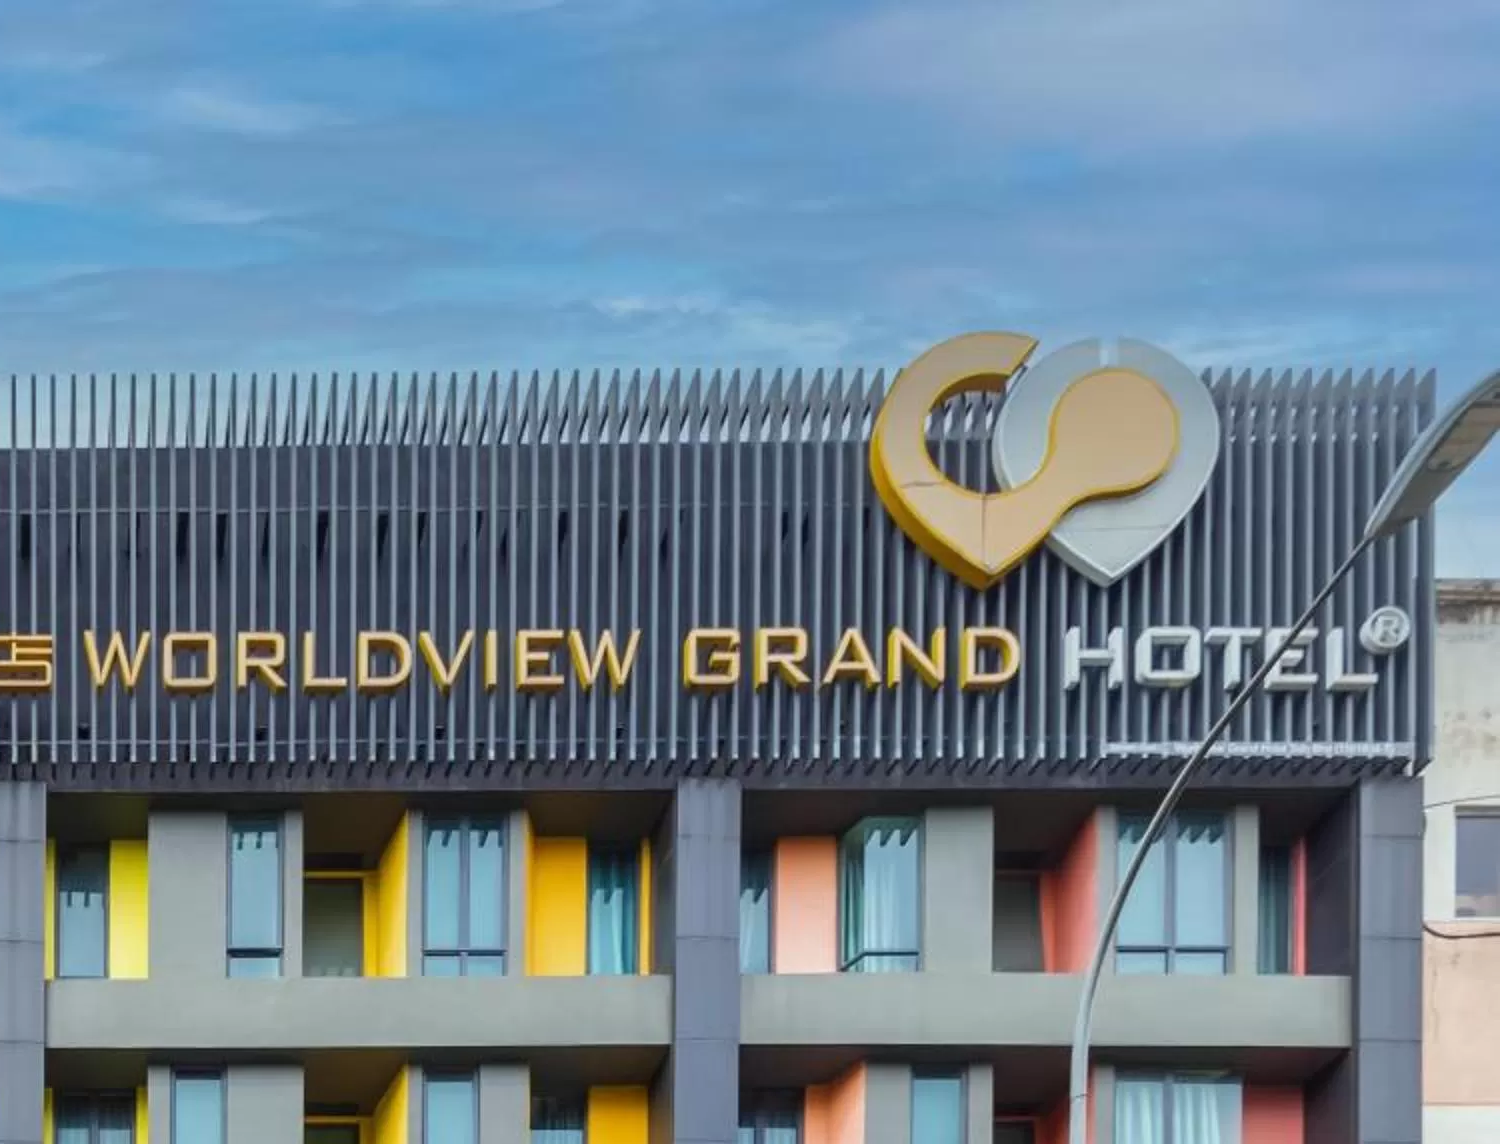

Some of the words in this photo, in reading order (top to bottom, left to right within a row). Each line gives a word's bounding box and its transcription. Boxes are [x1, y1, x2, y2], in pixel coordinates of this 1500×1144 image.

[83, 628, 641, 691] WORLDVIEW
[683, 627, 1022, 690] GRAND
[1064, 626, 1379, 690] HOTEL
